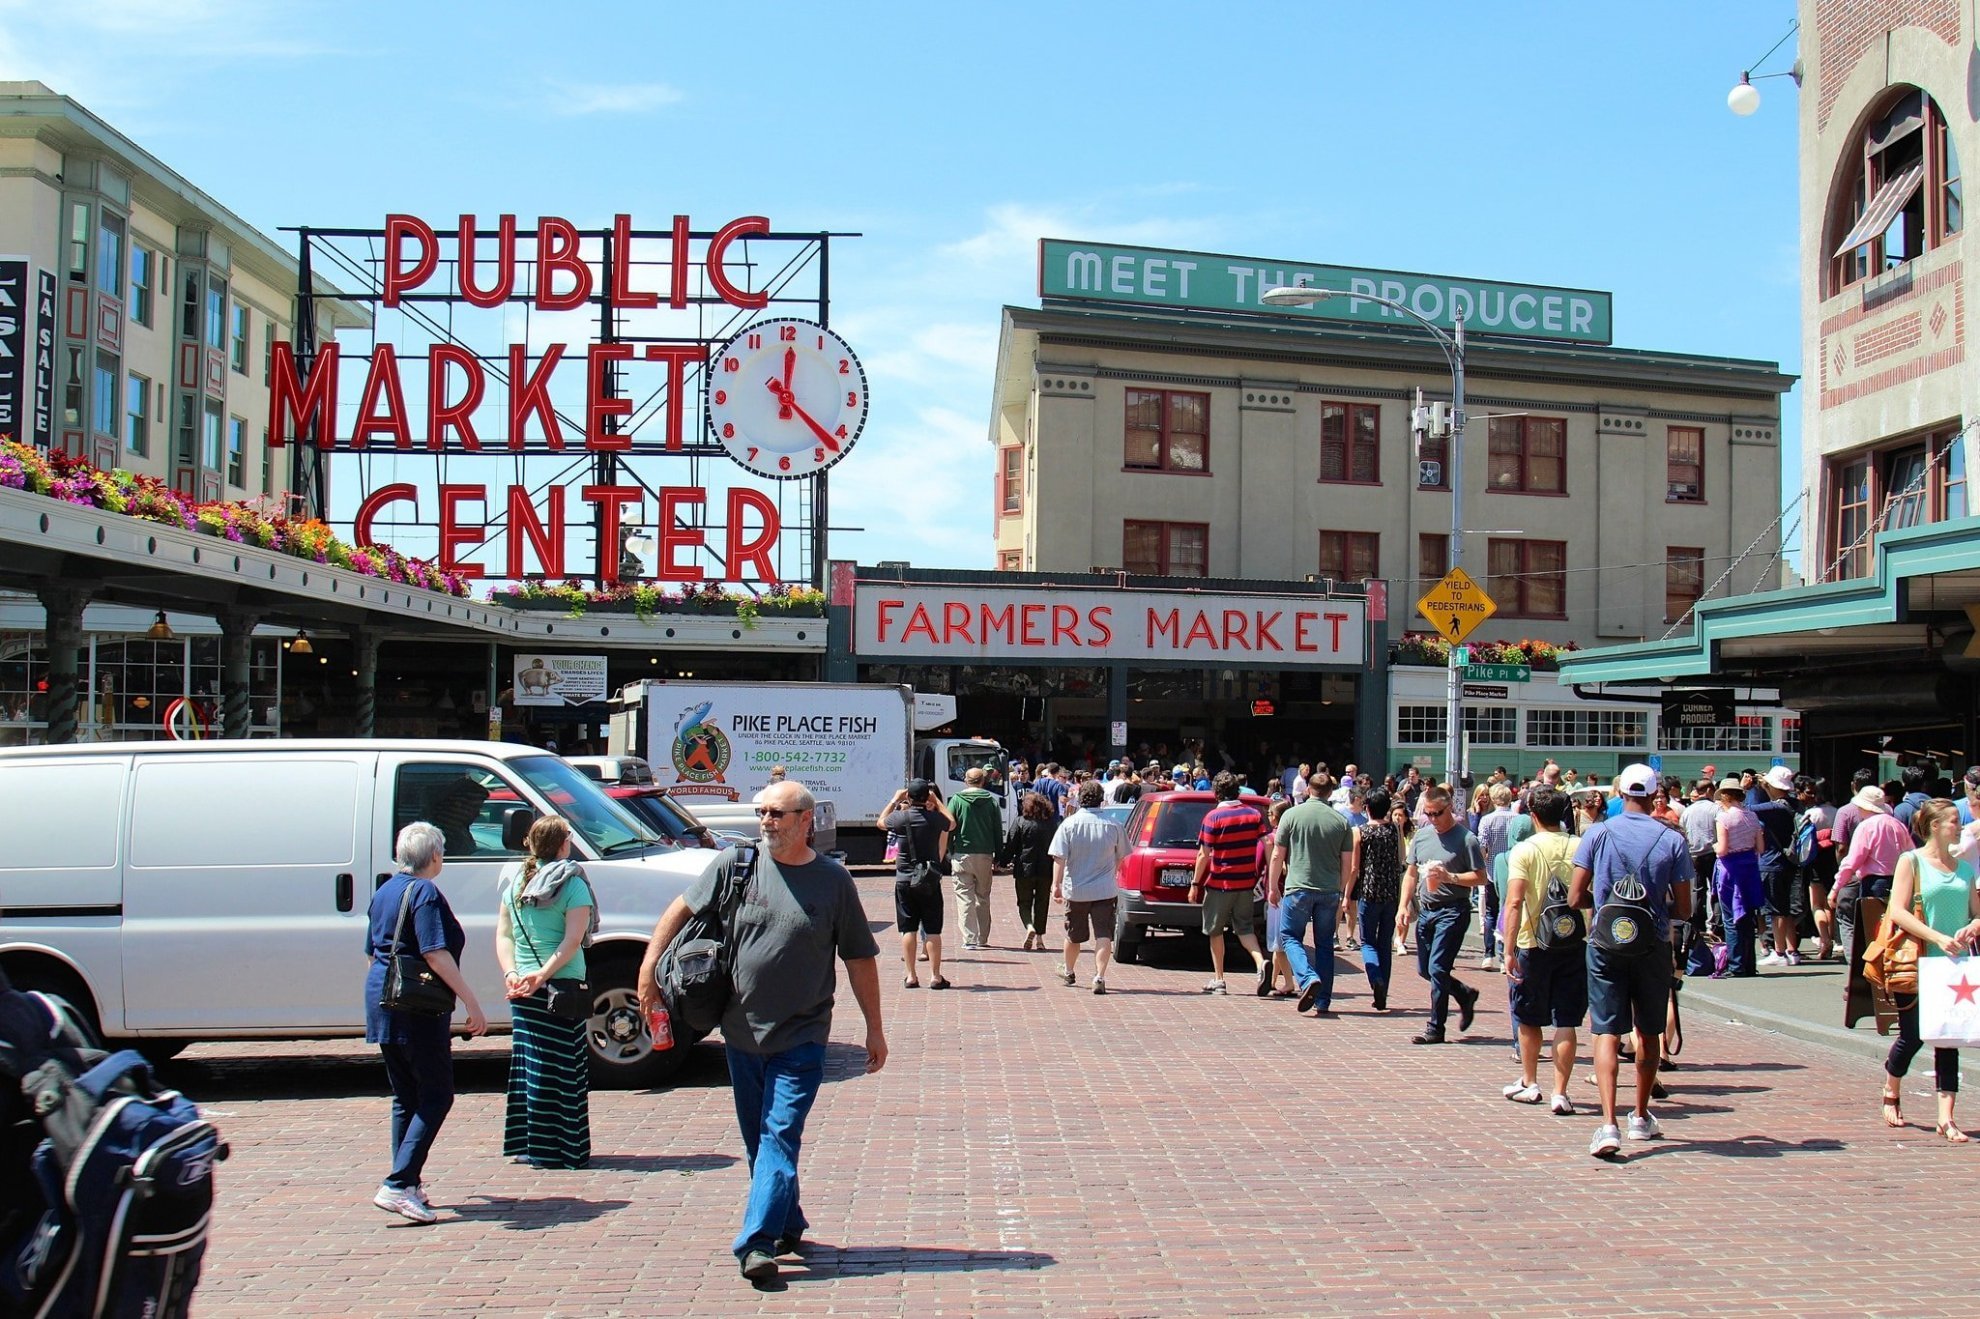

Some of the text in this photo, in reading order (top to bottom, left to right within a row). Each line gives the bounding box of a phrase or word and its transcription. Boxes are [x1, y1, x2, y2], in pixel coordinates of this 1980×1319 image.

[384, 213, 770, 310] PUBLIC
[41, 274, 53, 318] LA
[1066, 251, 1197, 298] MEET
[1350, 277, 1593, 334] PRODUCER
[780, 326, 796, 340] 12
[749, 335, 760, 349] 11
[818, 336, 823, 350] 1
[724, 358, 739, 372] 10
[839, 360, 849, 373] 2
[36, 328, 51, 432] SALLE
[269, 342, 709, 452] MARKET
[715, 391, 727, 405] 9
[847, 392, 857, 407] 3
[723, 423, 734, 438] 8
[835, 424, 848, 439] 4
[747, 447, 758, 461] 7
[814, 448, 825, 462] 5
[779, 457, 790, 471] 6
[354, 484, 781, 585] CENTER
[1444, 581, 1470, 590] YIELD
[1451, 591, 1463, 600] TO
[1426, 602, 1486, 612] PEDESTRIANS
[876, 599, 1348, 652] FARMERS MARKET
[1467, 664, 1508, 679] Pike Pl
[732, 715, 877, 733] PIKE PLACE FISH
[1680, 713, 1716, 724] PRODUCE
[674, 737, 728, 780] PIKE PLACE FISH MARKET
[743, 751, 847, 763] 1-800-542-7732
[749, 765, 842, 773] wwweplacefish.com
[699, 787, 733, 795] FAMOUS
